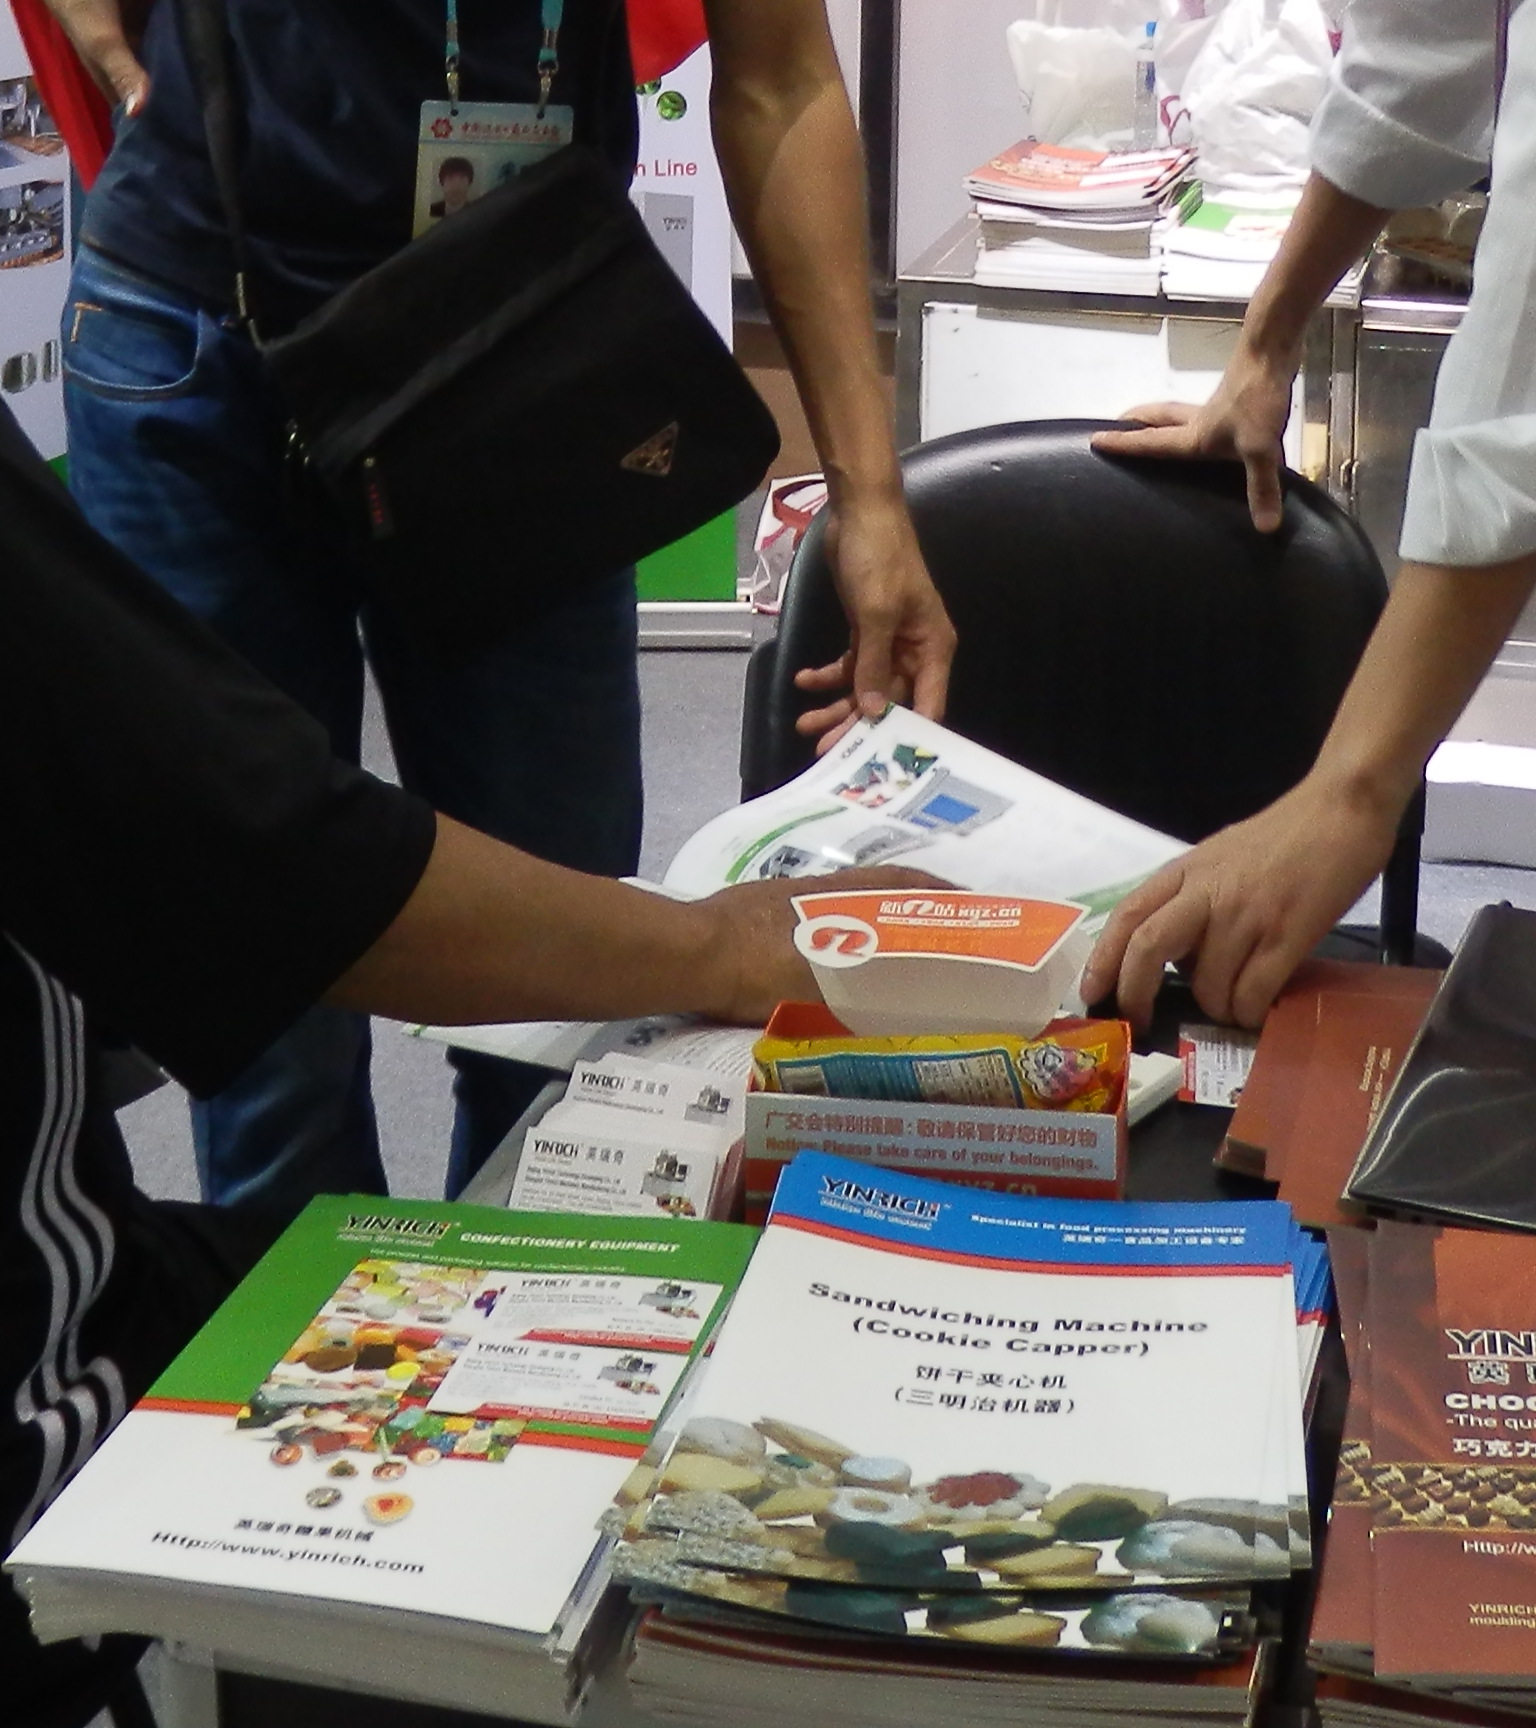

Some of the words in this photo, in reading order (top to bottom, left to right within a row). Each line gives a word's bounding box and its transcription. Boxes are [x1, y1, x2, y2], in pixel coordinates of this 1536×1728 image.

[654, 159, 698, 177] Line
[877, 1142, 909, 1158] take
[914, 1148, 947, 1161] care
[952, 1148, 967, 1162] of
[971, 1151, 1005, 1165] your
[822, 1175, 941, 1218] YINRICH
[460, 1232, 587, 1250] CONFECTIONERY
[589, 1240, 681, 1254] EQUIPMENT
[807, 1281, 1040, 1334] Sandwiching
[1053, 1318, 1209, 1334] Machine
[852, 1315, 992, 1351] (Cookie
[1004, 1337, 1150, 1357] Capper)
[916, 1364, 1068, 1391] 饼干夹心机
[152, 1531, 425, 1573] Http://www.yinrich.com
[1469, 1616, 1536, 1628] moulding
